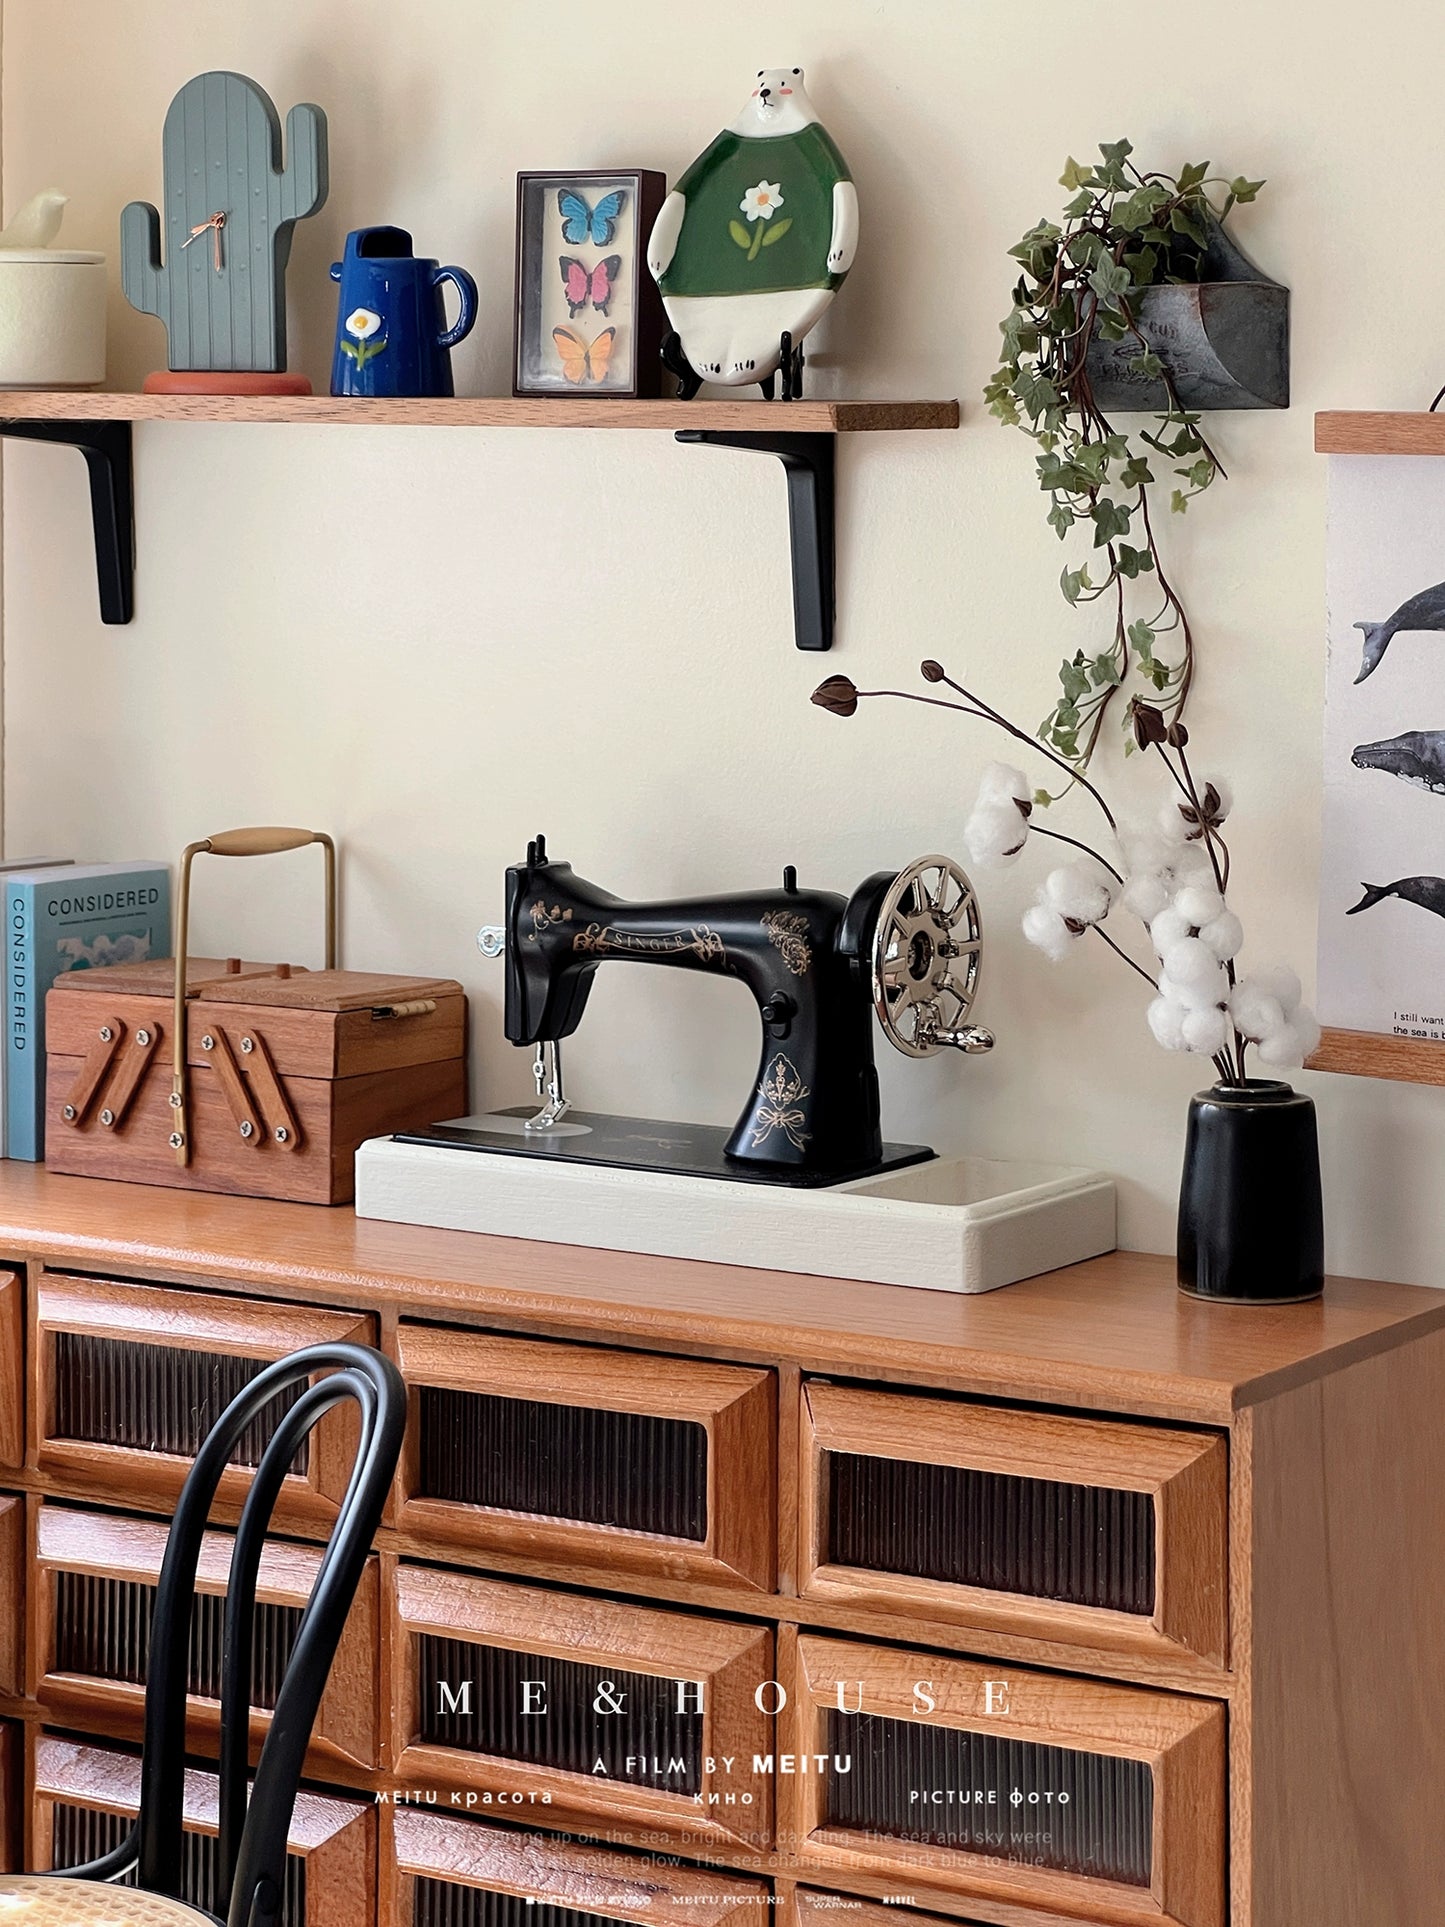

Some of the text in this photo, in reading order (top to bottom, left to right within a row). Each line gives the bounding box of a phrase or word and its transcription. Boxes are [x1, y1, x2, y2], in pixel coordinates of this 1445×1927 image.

[48, 888, 159, 917] CONSIDERED
[614, 932, 685, 951] SINGER
[12, 898, 26, 1050] CONSIDERED
[1400, 1013, 1418, 1022] still
[1421, 1016, 1444, 1025] want
[1393, 1025, 1408, 1035] the
[1411, 1029, 1427, 1037] sea
[1430, 1029, 1439, 1039] is
